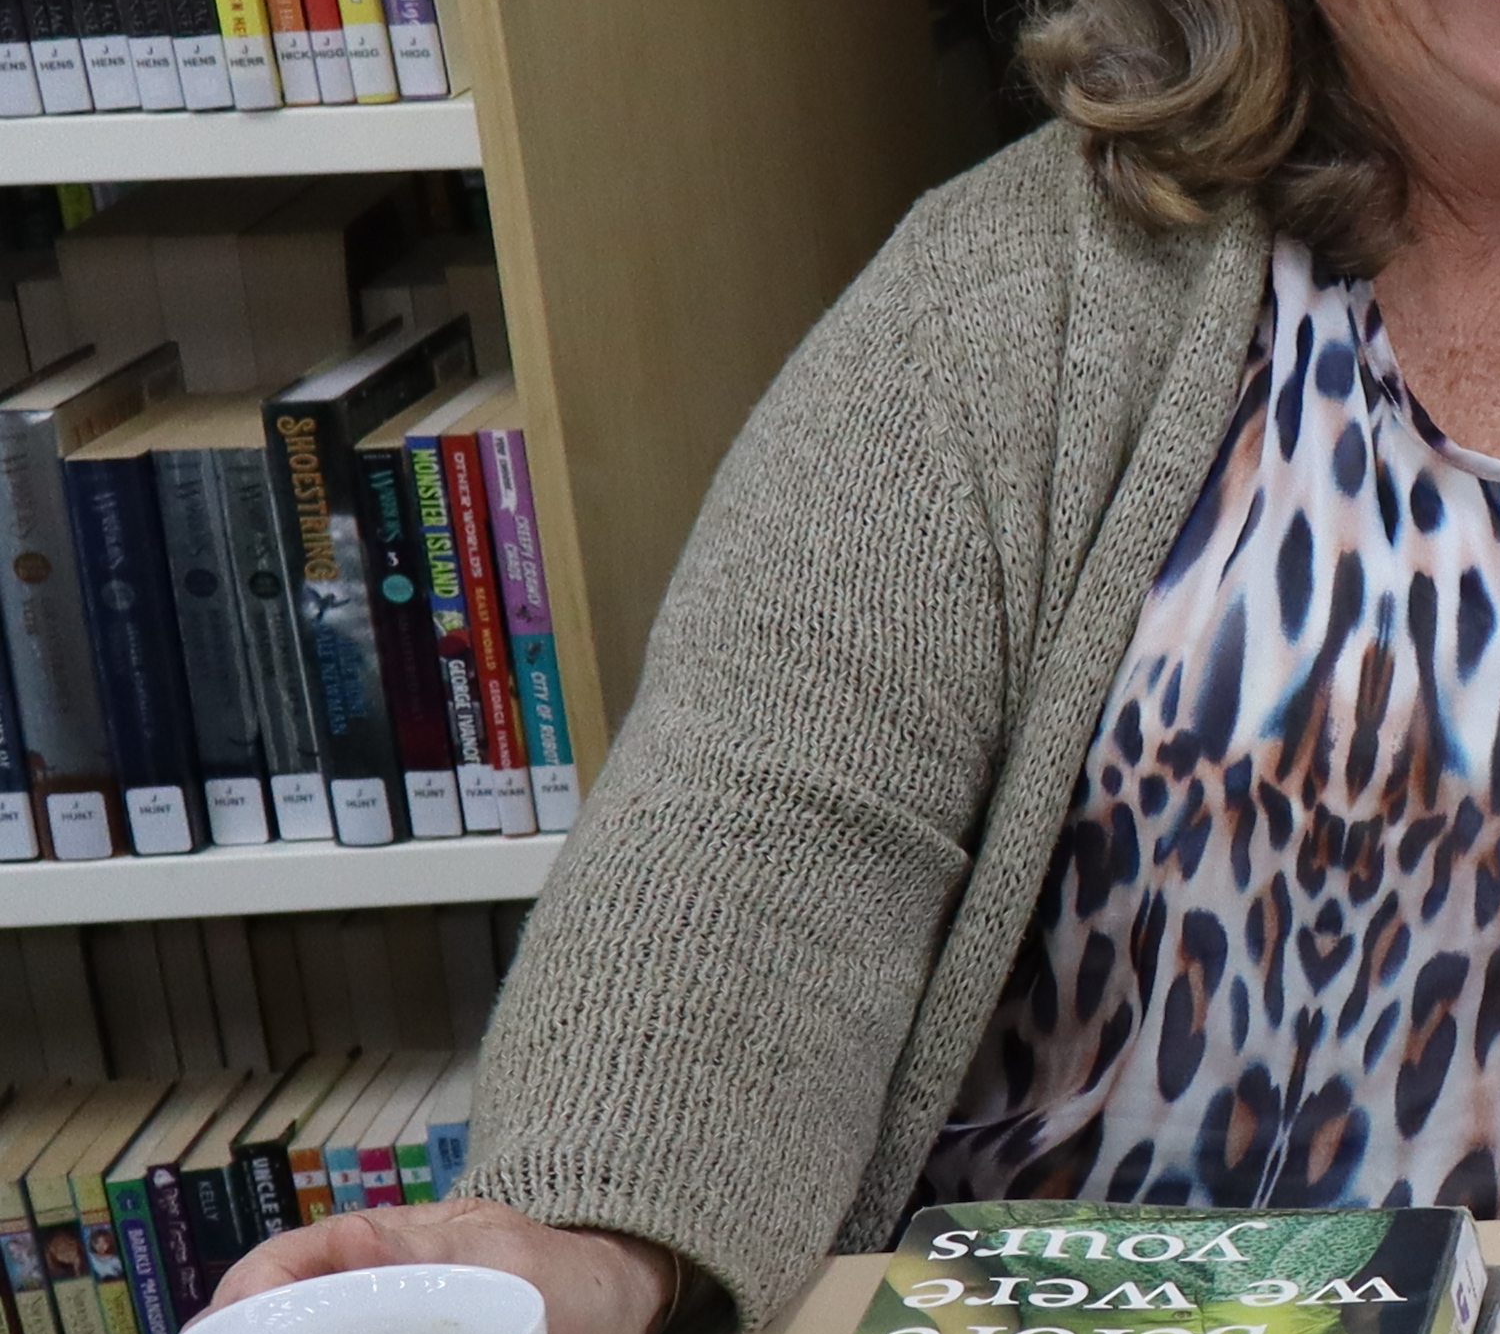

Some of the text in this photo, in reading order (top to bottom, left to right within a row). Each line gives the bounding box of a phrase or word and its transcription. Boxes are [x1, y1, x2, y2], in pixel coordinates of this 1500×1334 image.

[410, 448, 459, 599] MONSTER ISLAND
[200, 1180, 221, 1222] KELLY
[252, 1157, 280, 1214] UNCLE
[927, 1221, 1270, 1262] yours
[903, 1277, 1408, 1309] we were
